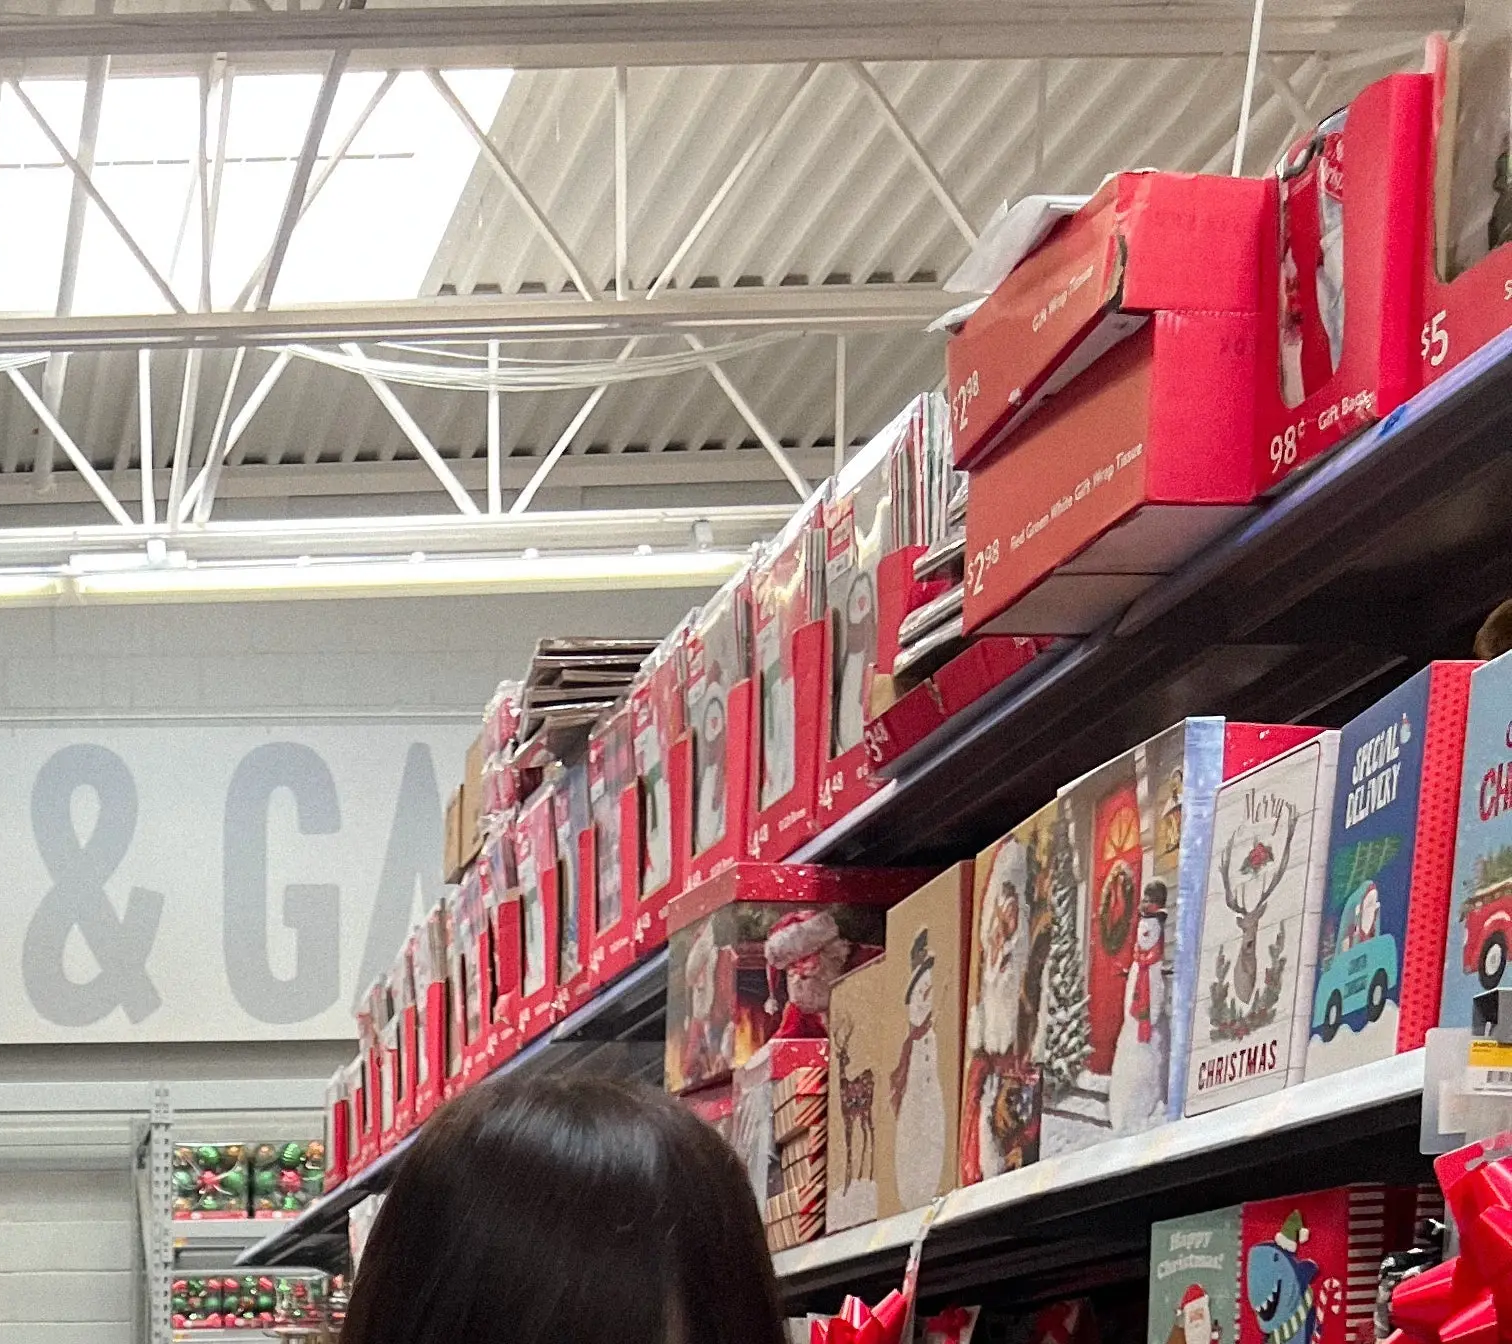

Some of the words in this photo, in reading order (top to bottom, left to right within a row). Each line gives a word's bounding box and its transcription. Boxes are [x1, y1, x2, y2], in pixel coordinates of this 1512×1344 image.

[1419, 309, 1450, 367] $5
[1317, 403, 1340, 431] Gift
[1244, 787, 1289, 836] Merry
[22, 741, 167, 1028] &
[1197, 1040, 1279, 1091] CHRISTMAS
